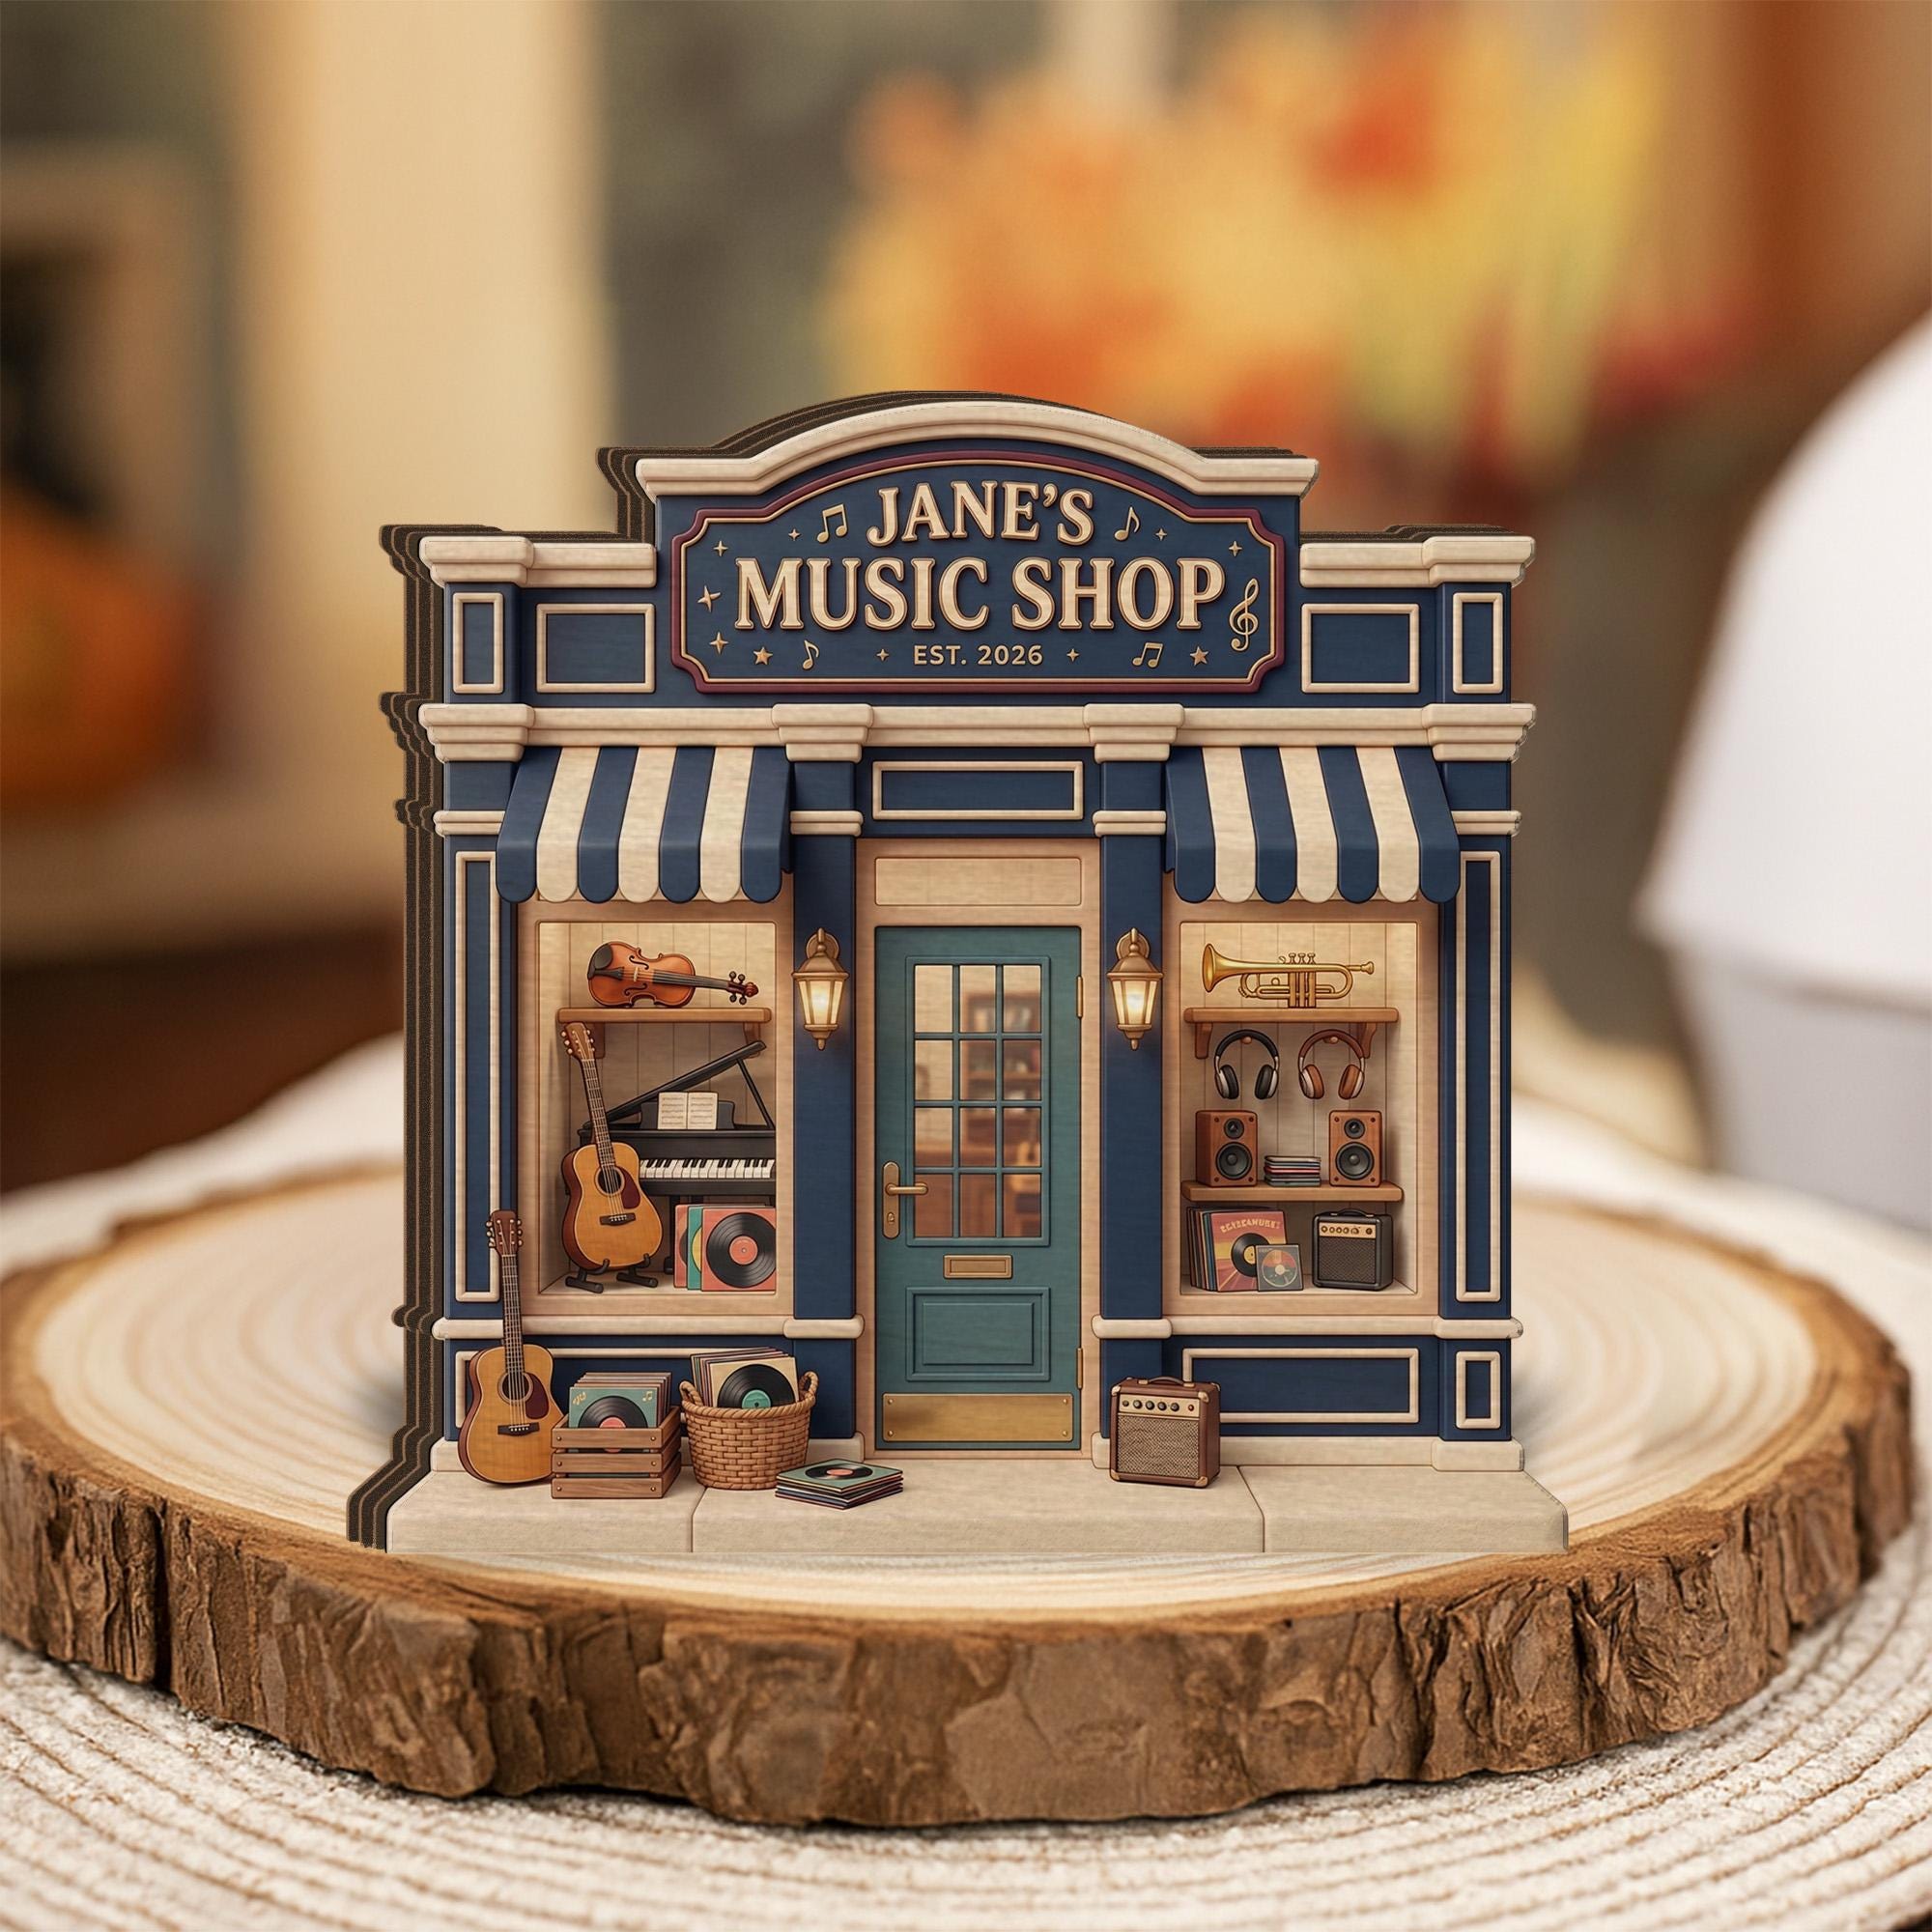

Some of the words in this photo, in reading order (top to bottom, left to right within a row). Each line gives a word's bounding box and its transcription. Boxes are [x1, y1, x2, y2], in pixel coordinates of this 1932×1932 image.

[866, 482, 1094, 547] JANE’S
[734, 557, 989, 631] MUSIC
[1011, 557, 1227, 631] SHOP
[913, 645, 967, 667] EST.
[978, 645, 1044, 667] 2026
